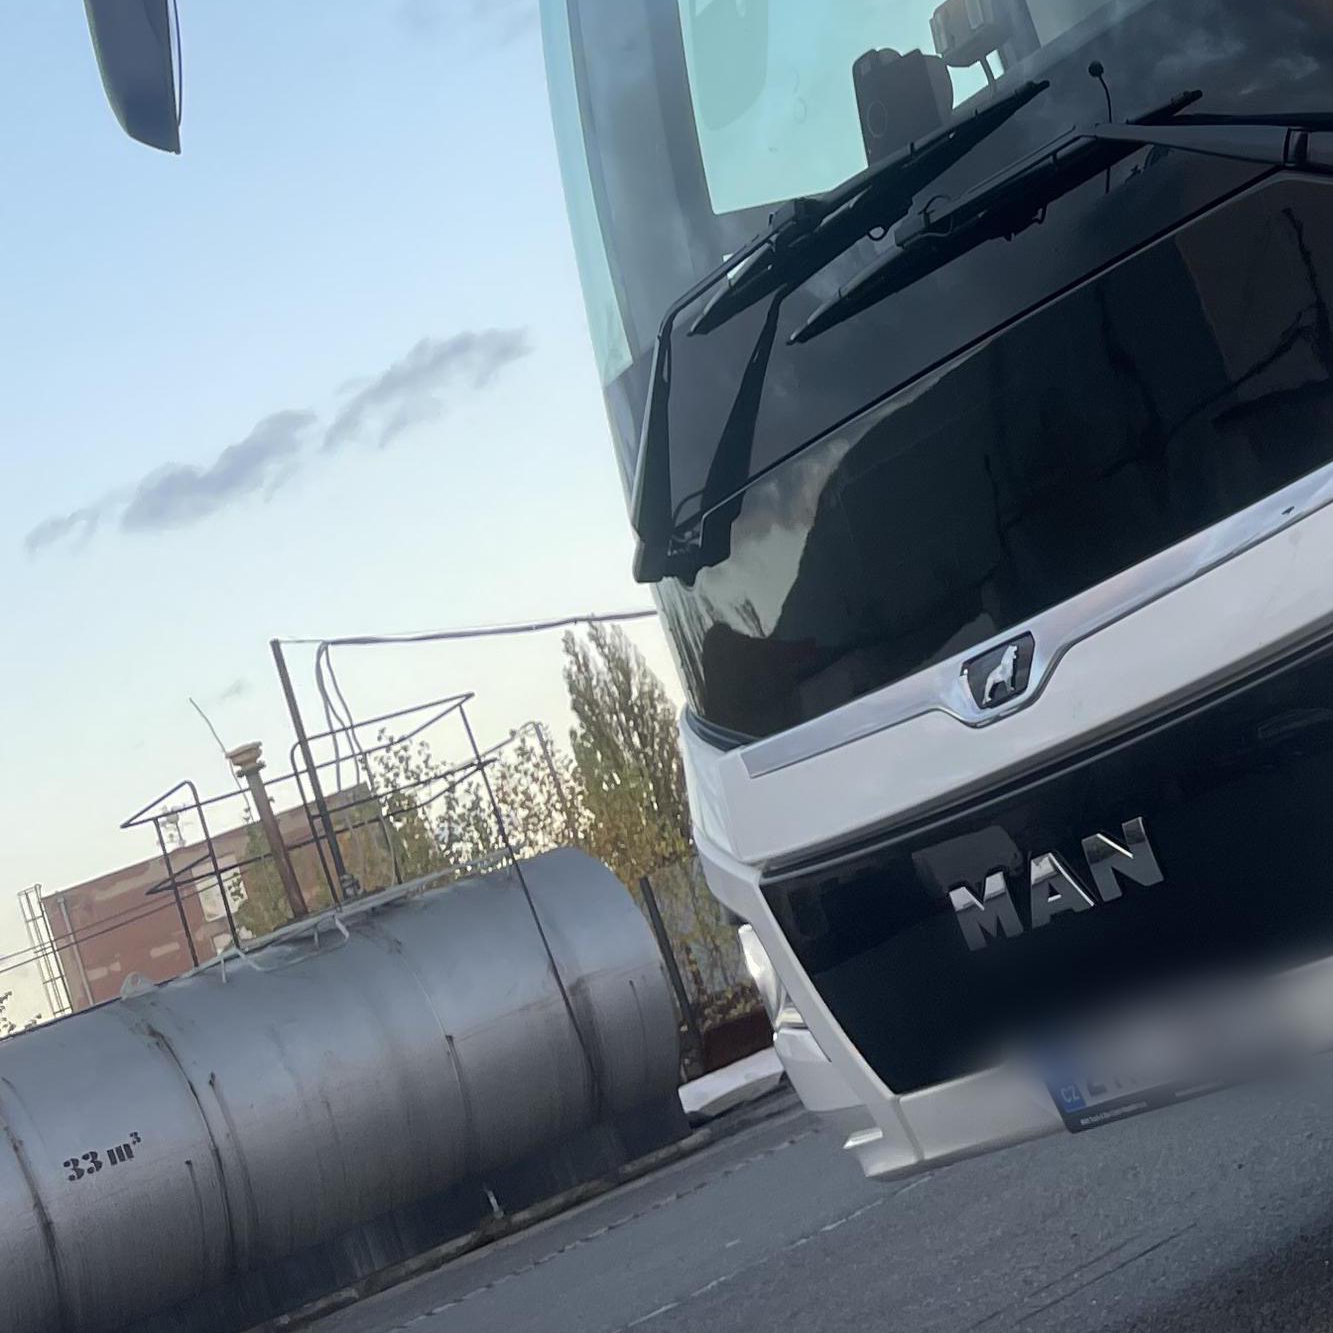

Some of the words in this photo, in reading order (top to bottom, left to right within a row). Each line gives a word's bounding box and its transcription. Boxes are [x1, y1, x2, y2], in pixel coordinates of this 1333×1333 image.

[949, 816, 1164, 952] MAN
[1060, 1084, 1080, 1103] CZ
[63, 1151, 103, 1182] 33
